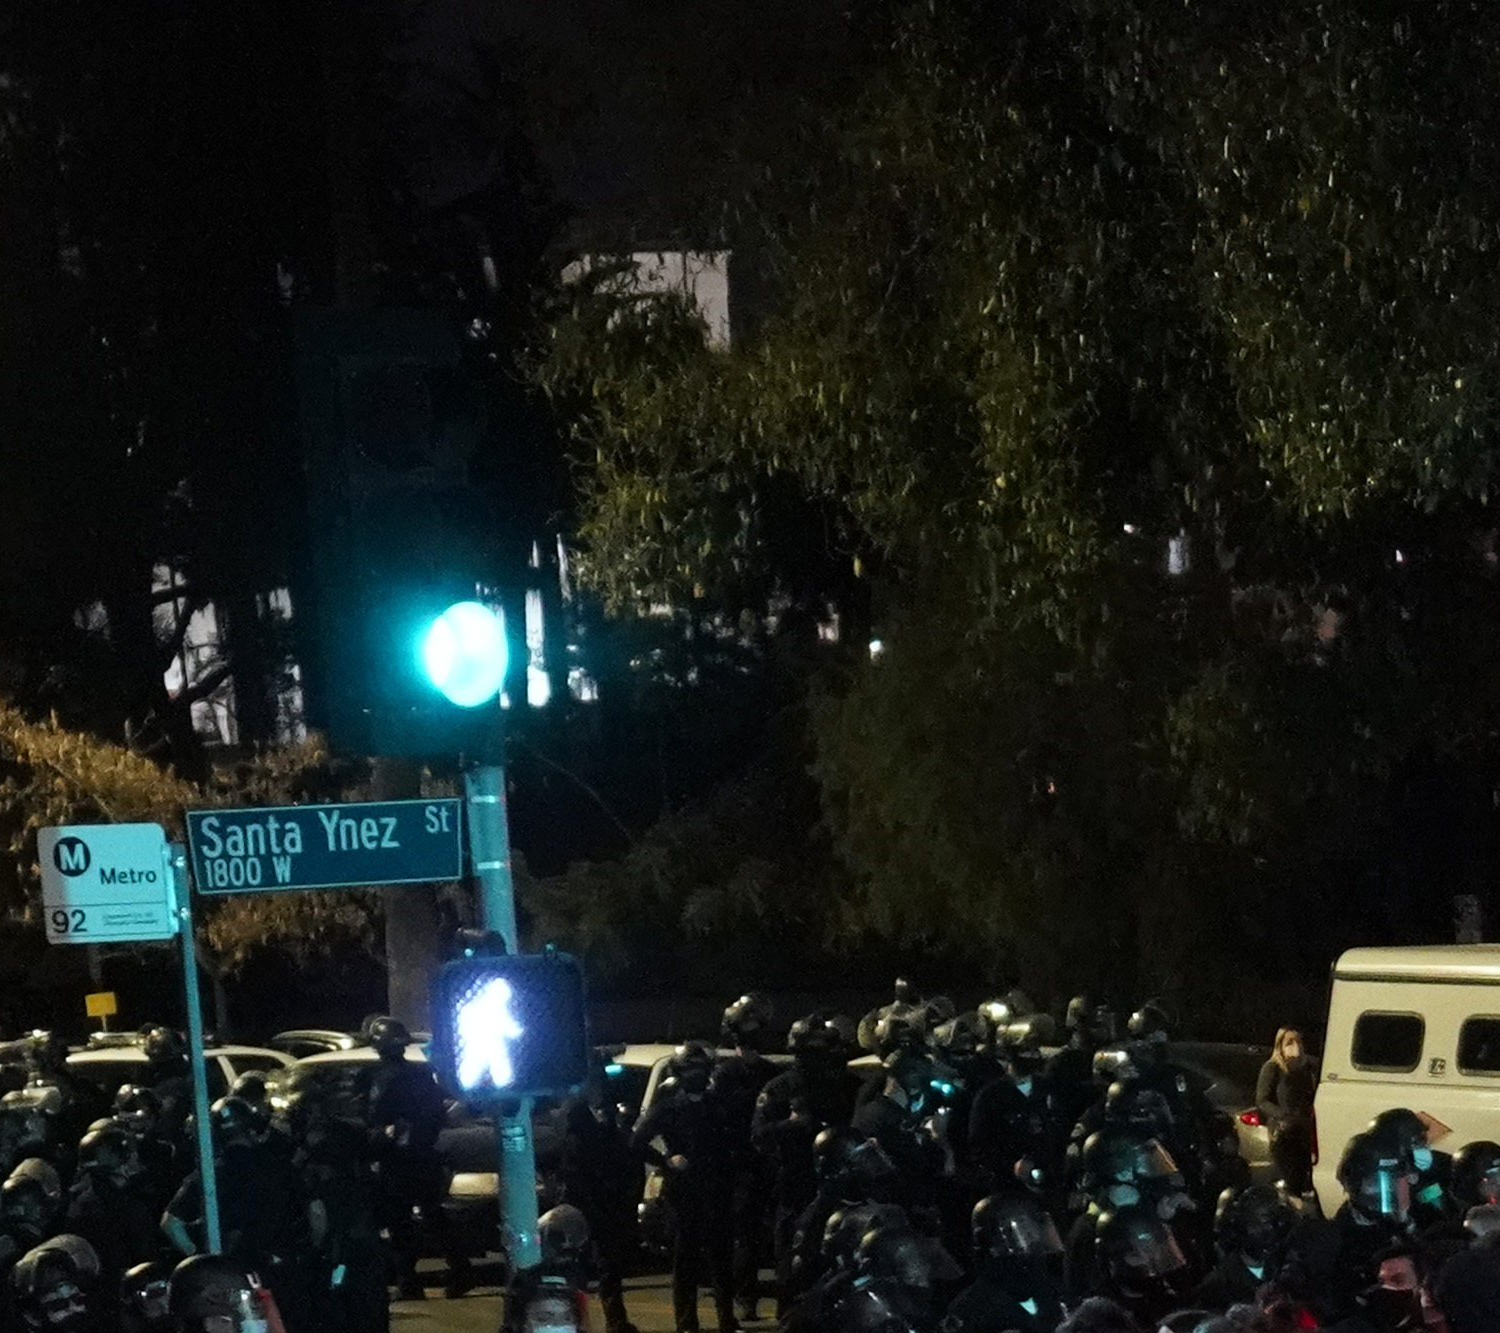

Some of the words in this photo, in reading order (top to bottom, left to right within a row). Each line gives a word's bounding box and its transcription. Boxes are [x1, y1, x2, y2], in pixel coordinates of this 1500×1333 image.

[200, 816, 302, 858] Santa
[318, 810, 399, 851] Ynez
[425, 805, 450, 834] St
[99, 866, 157, 885] Metro
[204, 857, 262, 888] 1800
[272, 855, 291, 884] W
[52, 909, 87, 934] 92
